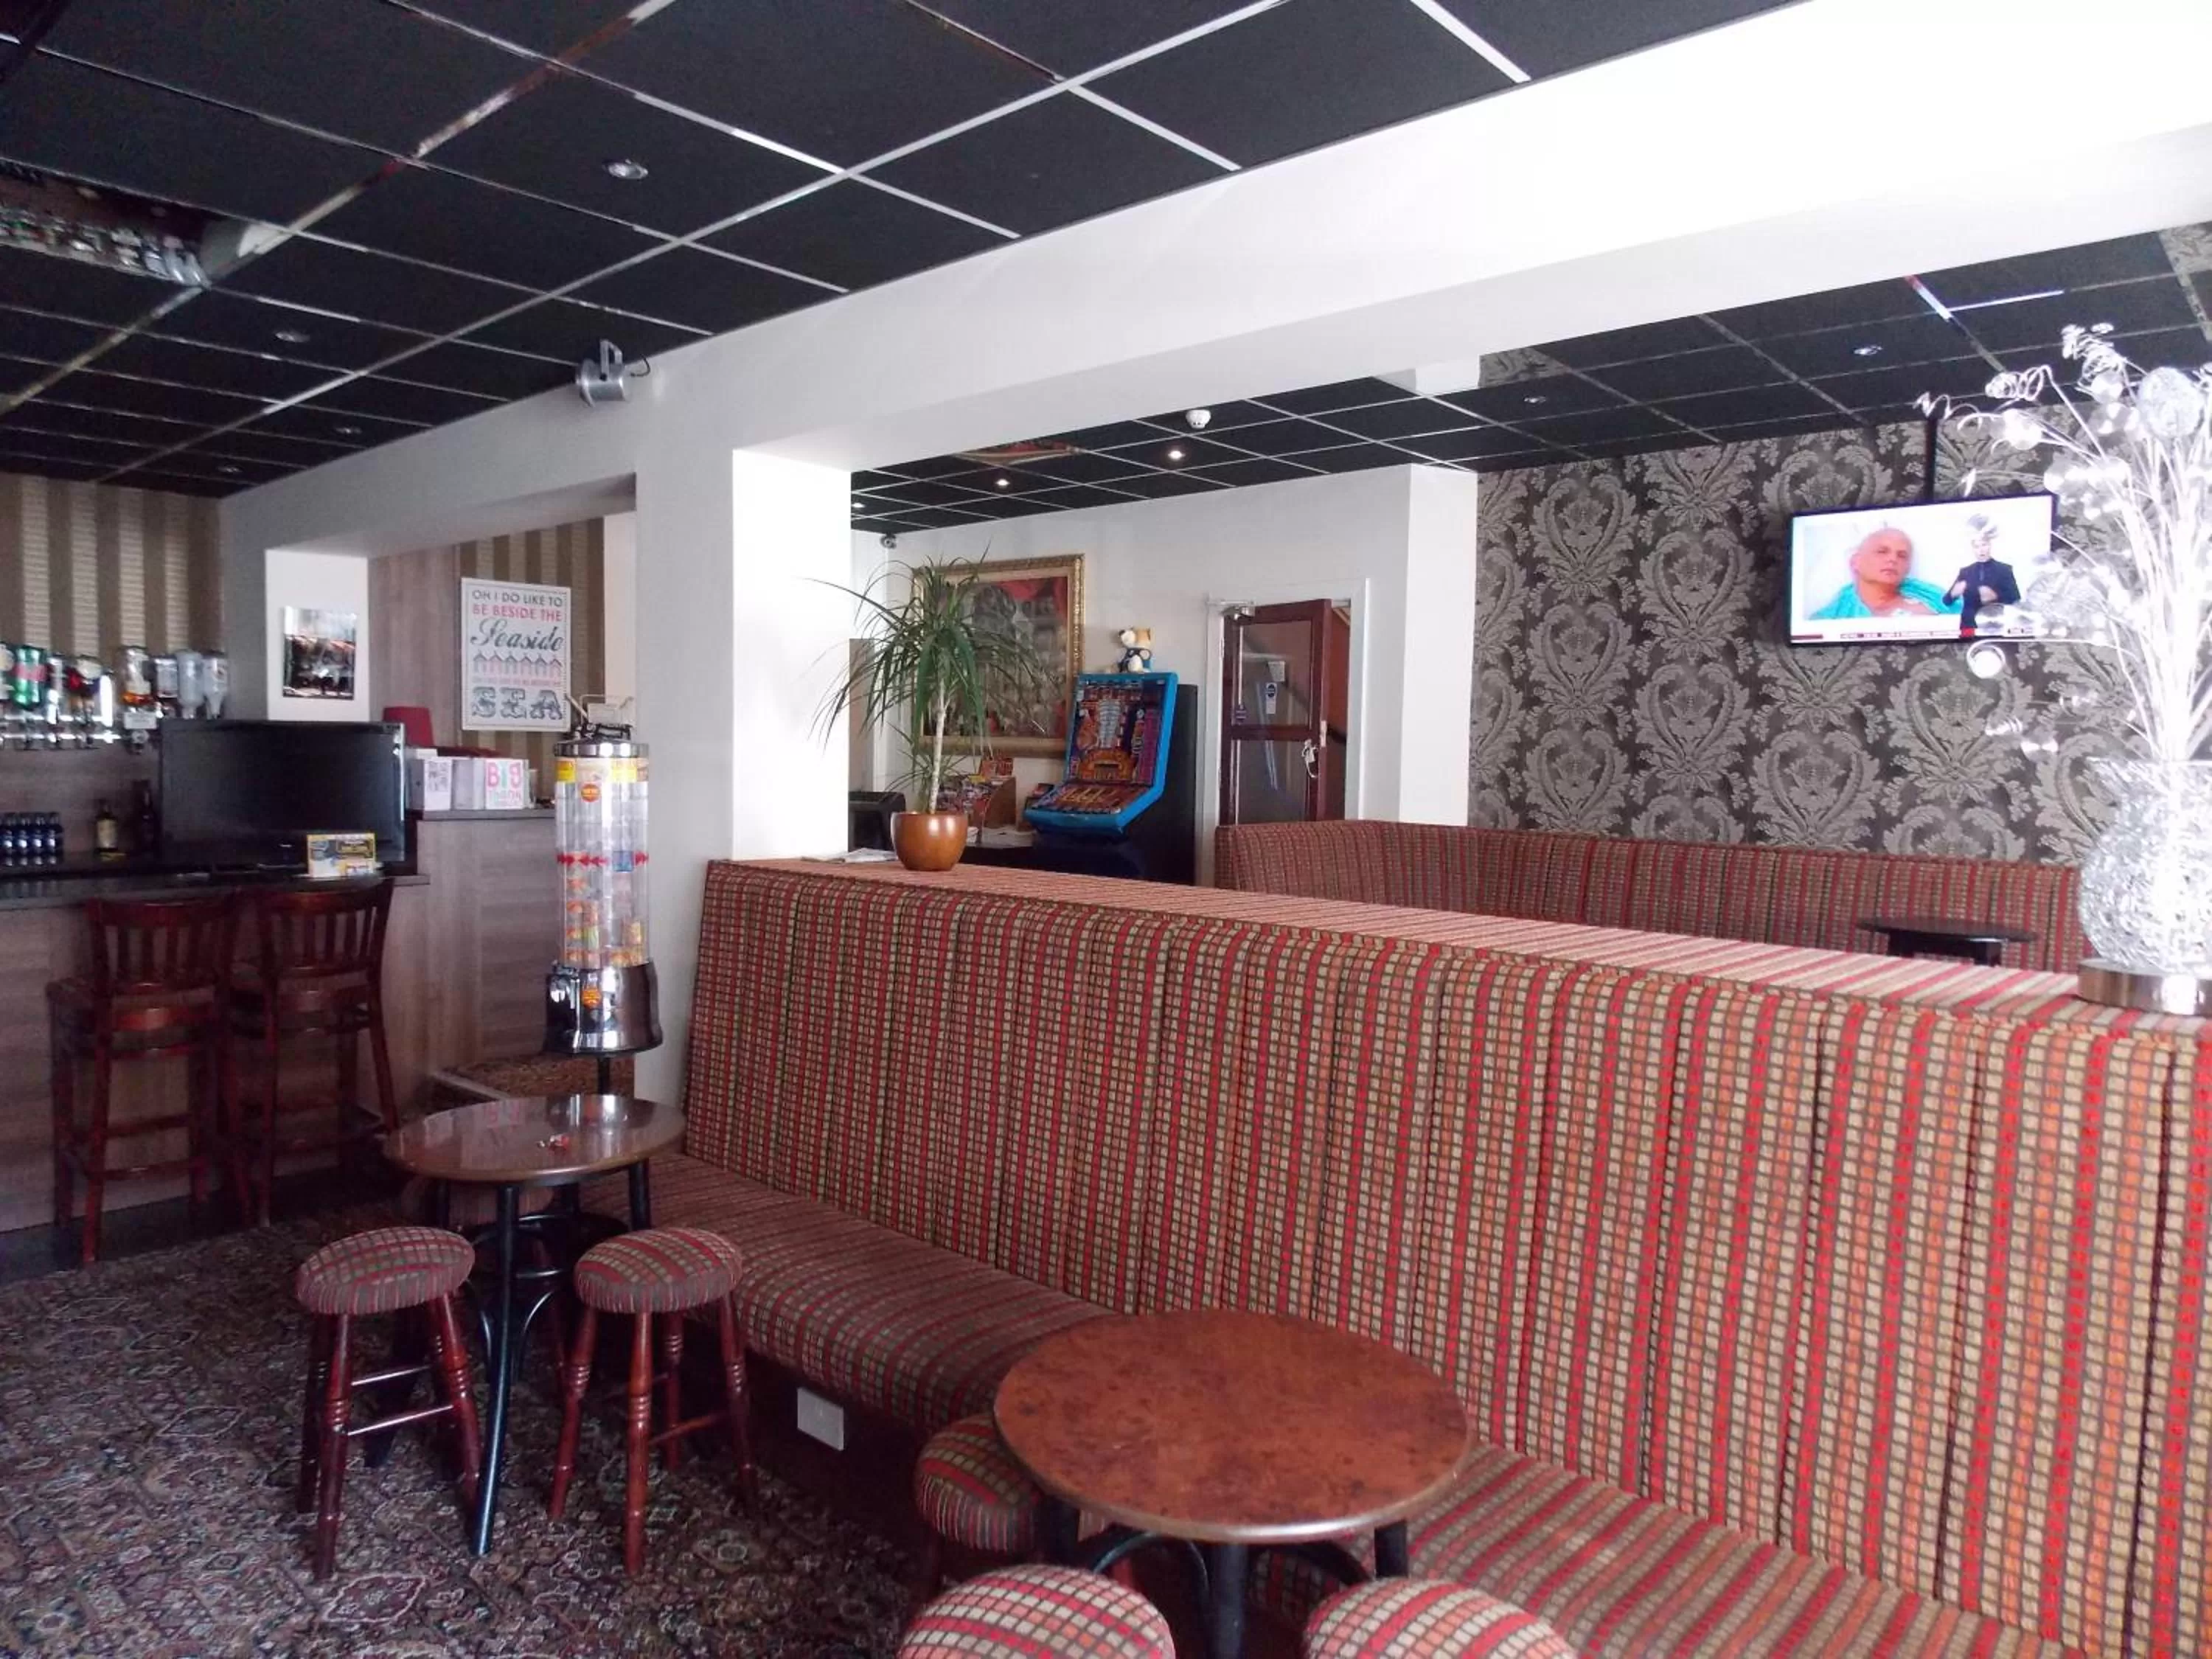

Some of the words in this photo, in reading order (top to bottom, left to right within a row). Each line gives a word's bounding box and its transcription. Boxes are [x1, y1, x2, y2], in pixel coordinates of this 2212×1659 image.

[472, 591, 490, 600] OH
[502, 592, 519, 603] DO
[524, 595, 544, 605] LIKE
[549, 597, 563, 607] TO
[473, 605, 490, 615] BE
[493, 605, 537, 619] BESIDE
[540, 609, 562, 622] THE
[470, 618, 563, 652] Seaside
[472, 686, 563, 720] SEA
